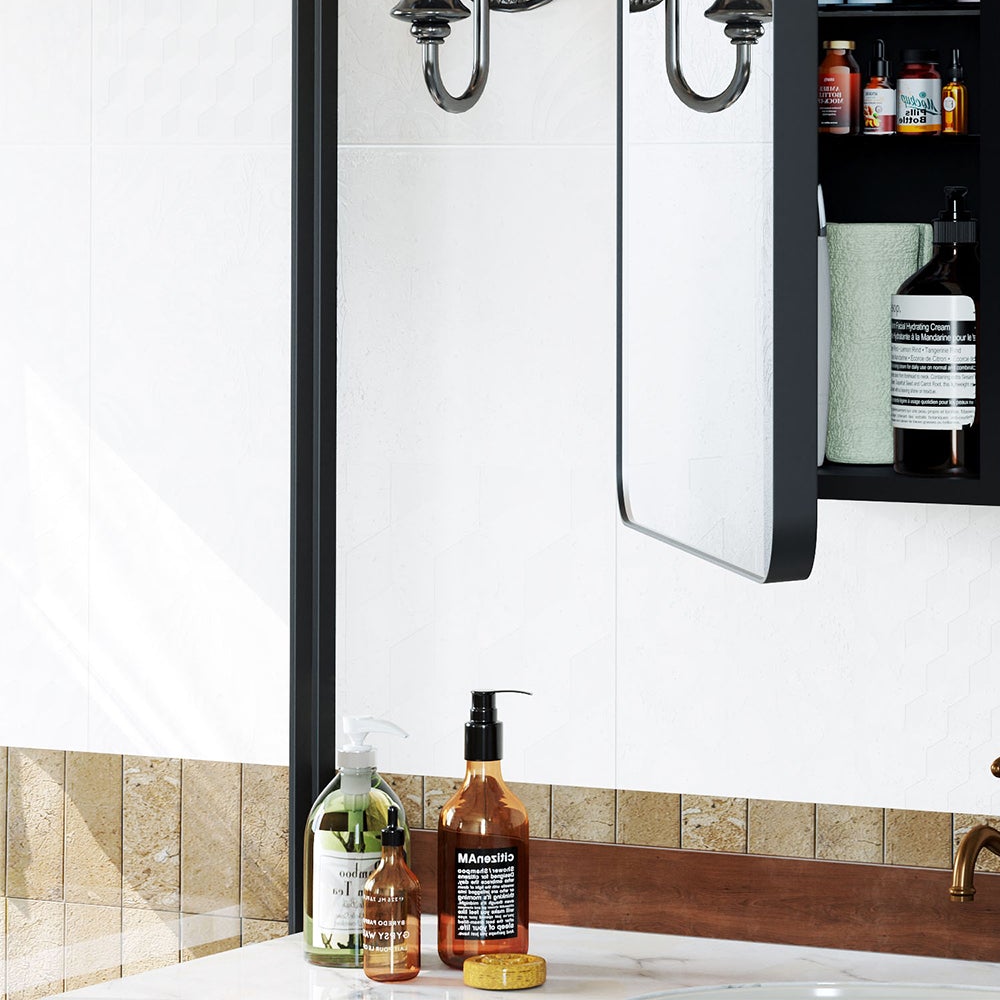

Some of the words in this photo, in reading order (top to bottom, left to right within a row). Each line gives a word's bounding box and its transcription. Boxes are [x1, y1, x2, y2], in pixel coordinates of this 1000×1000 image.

[906, 323, 929, 332] Hydrating
[930, 323, 950, 331] Cream
[921, 333, 951, 341] Mandarine
